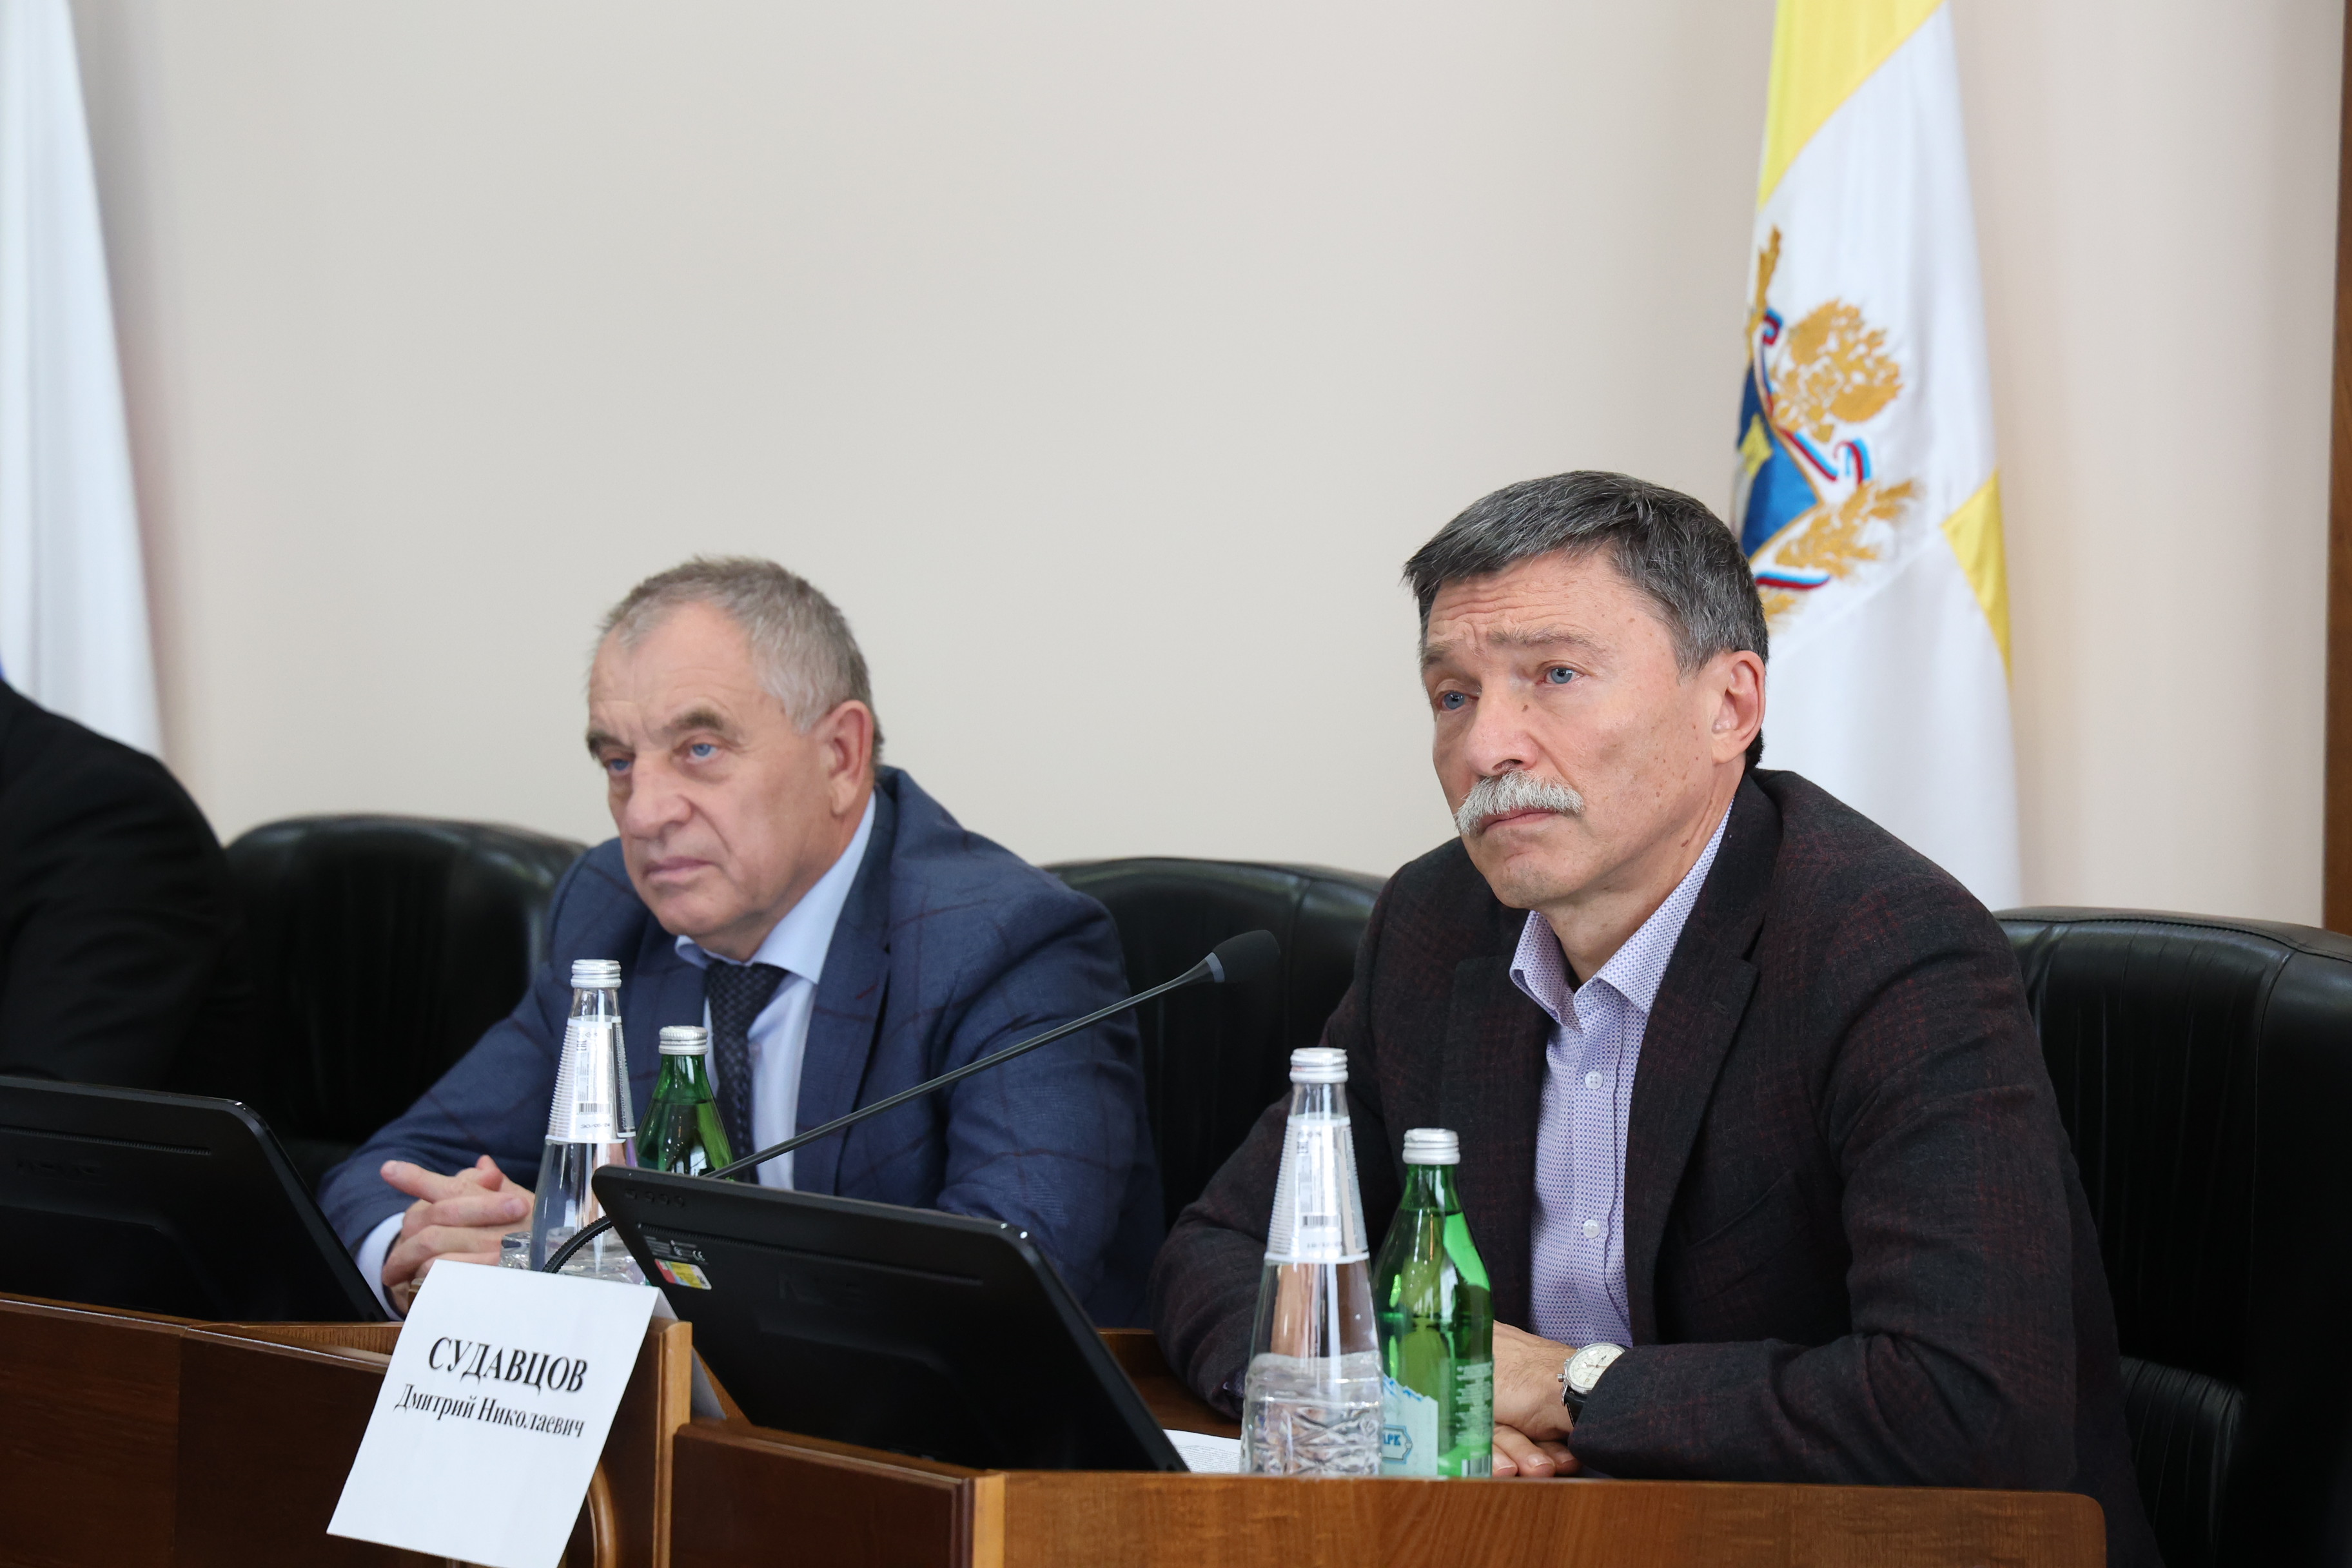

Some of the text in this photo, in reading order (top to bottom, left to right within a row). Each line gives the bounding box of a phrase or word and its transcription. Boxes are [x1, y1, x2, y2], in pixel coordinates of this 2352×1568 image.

[429, 1337, 588, 1395] СУДАВЦОВ
[394, 1384, 585, 1438] Дмитрий Николаевич
